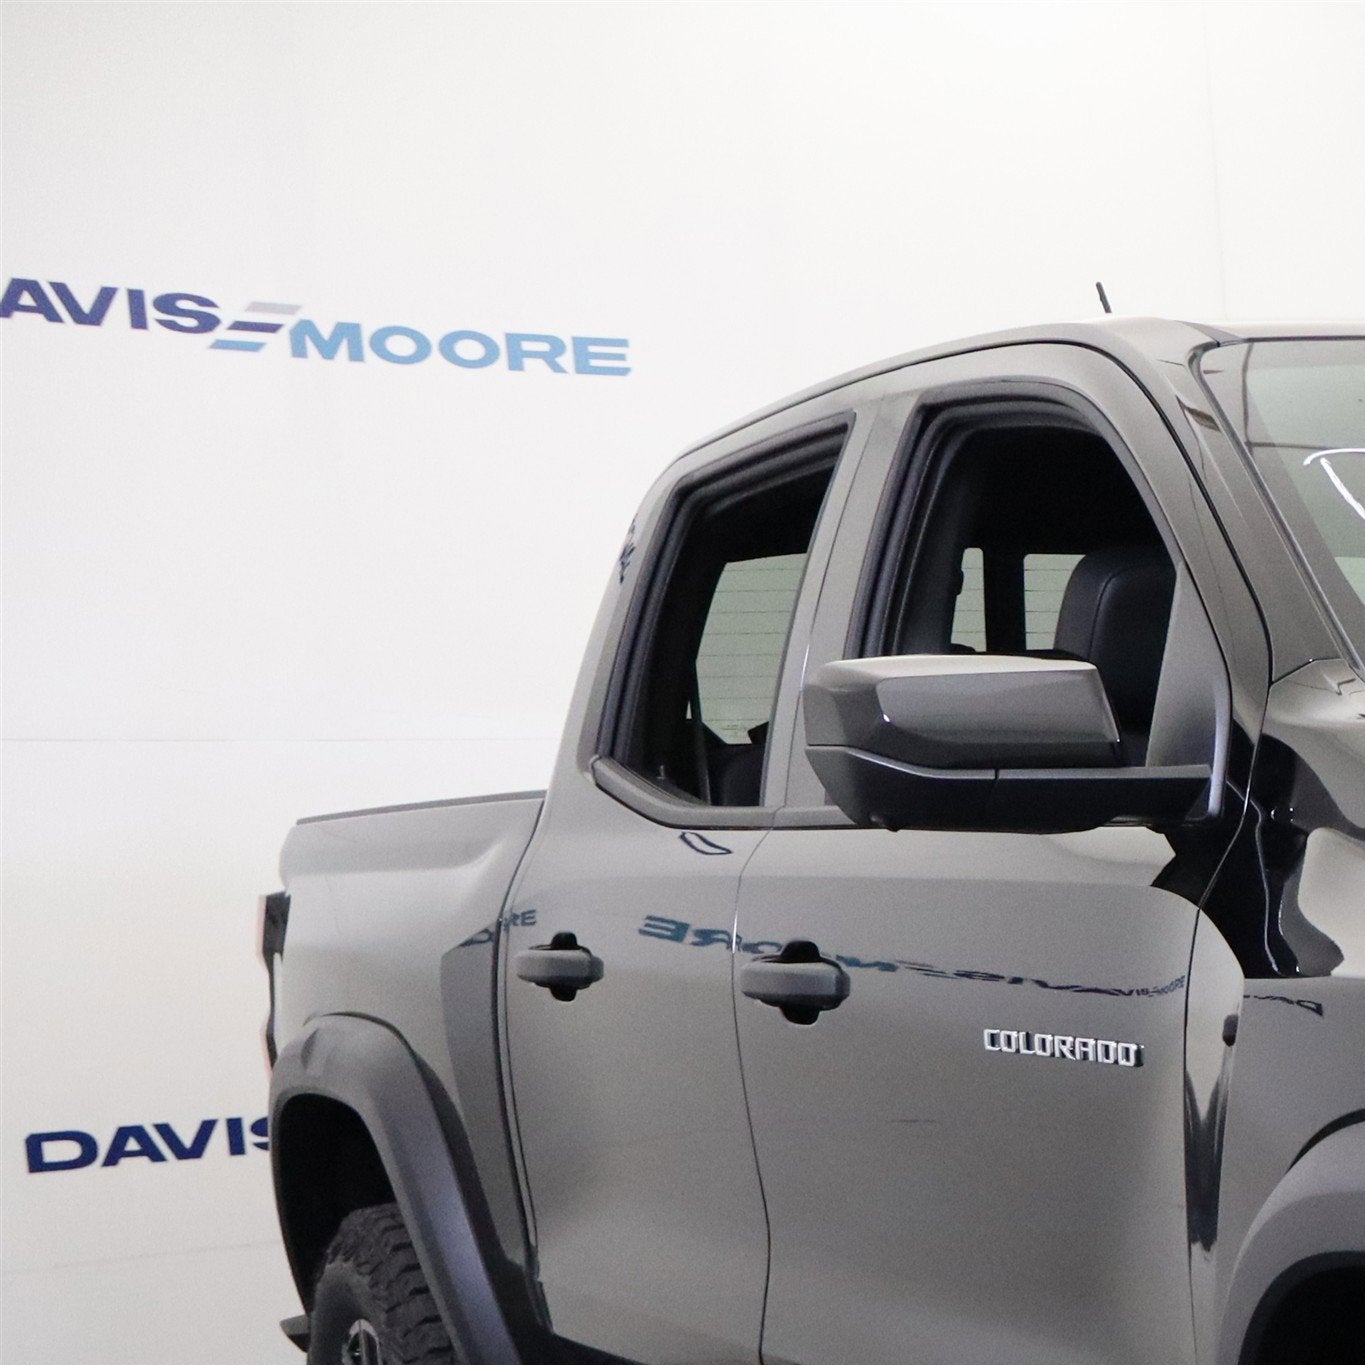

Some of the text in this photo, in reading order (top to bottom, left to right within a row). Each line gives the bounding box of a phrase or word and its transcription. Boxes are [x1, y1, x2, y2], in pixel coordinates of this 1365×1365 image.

[0, 277, 633, 377] AVIS MOORE
[984, 1028, 1138, 1067] COLORADO
